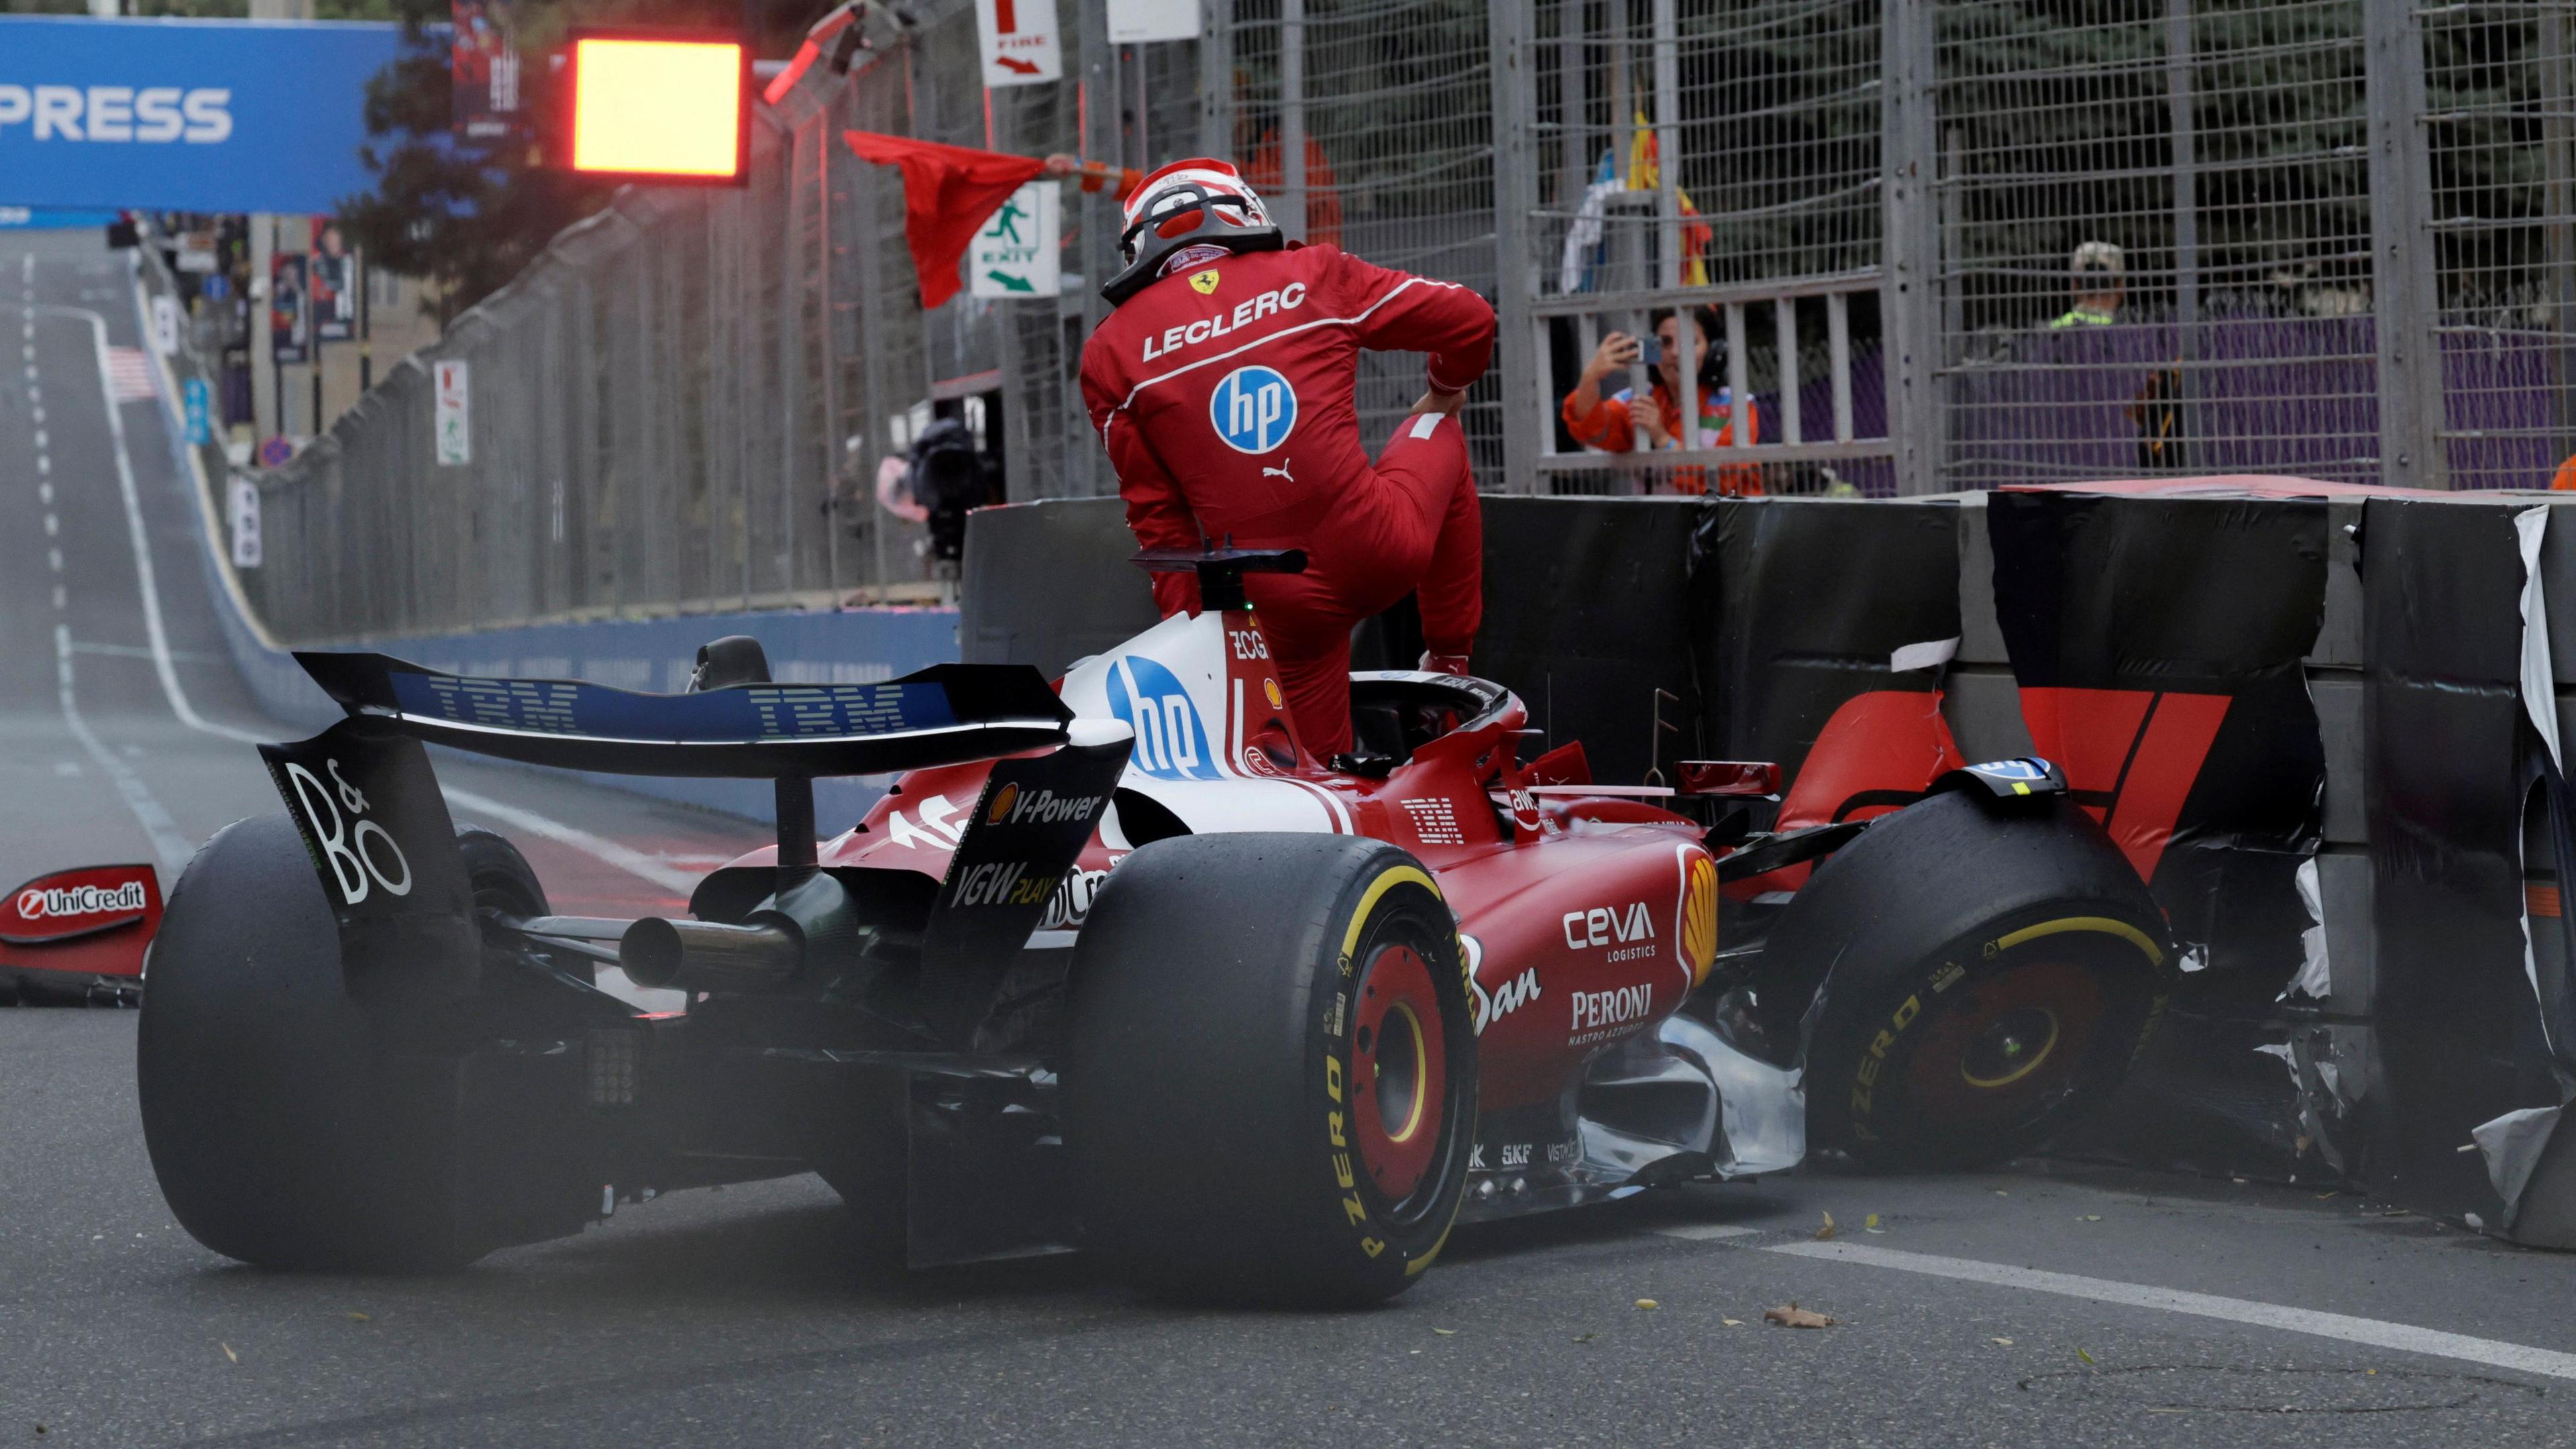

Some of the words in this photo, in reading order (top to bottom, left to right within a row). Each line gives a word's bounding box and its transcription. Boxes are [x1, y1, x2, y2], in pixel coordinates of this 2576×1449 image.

[997, 35, 1047, 49] FIRE
[981, 250, 1037, 264] EXIT
[1143, 282, 1306, 363] LECLERC
[1229, 370, 1281, 451] hp
[429, 676, 588, 735] IBM
[748, 684, 918, 739] IBM
[1116, 656, 1201, 780] hp
[1011, 790, 1101, 824] V-Power
[1401, 798, 1464, 844] IBM
[47, 883, 143, 912] UniCredit
[1607, 945, 1656, 963] LOGISTICS
[1571, 983, 1652, 1030] PERONI
[1568, 1030, 1605, 1046] NASTRO
[1851, 994, 1921, 1114] ZERO
[1326, 1055, 1366, 1226] ZERO
[1502, 1144, 1532, 1165] SKF
